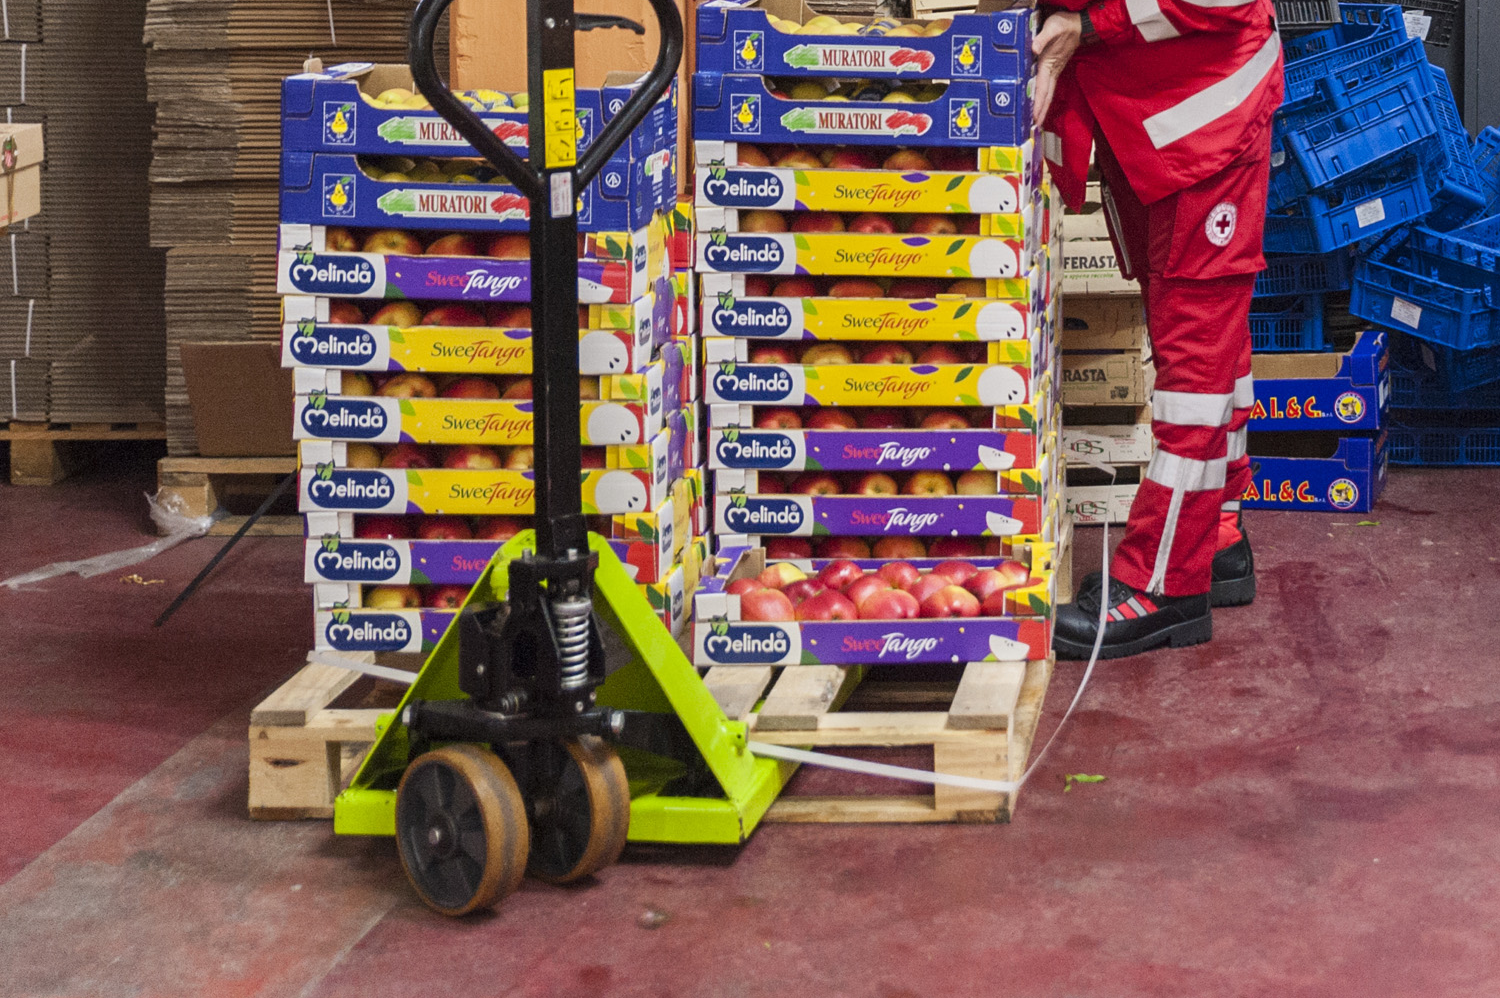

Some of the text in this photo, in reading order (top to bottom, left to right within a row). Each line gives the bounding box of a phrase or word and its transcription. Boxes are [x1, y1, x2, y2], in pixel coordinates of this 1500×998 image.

[822, 49, 886, 67] MURATORI
[419, 122, 463, 141] MURA
[818, 112, 882, 130] MURATORI
[706, 177, 780, 198] Melinda
[418, 194, 487, 214] MURATORI
[706, 242, 780, 263] Melinda
[293, 262, 371, 283] Melinda
[715, 307, 788, 328] Melinda
[294, 334, 372, 355] Melinda
[716, 372, 790, 393] Melinda
[304, 407, 384, 428] Melinda
[719, 439, 792, 460] Melinda
[311, 476, 390, 498] Melinda
[727, 504, 800, 525] Melinda
[317, 548, 396, 570] Melinda
[329, 620, 407, 641] Melinda
[707, 631, 787, 653] Melinda
